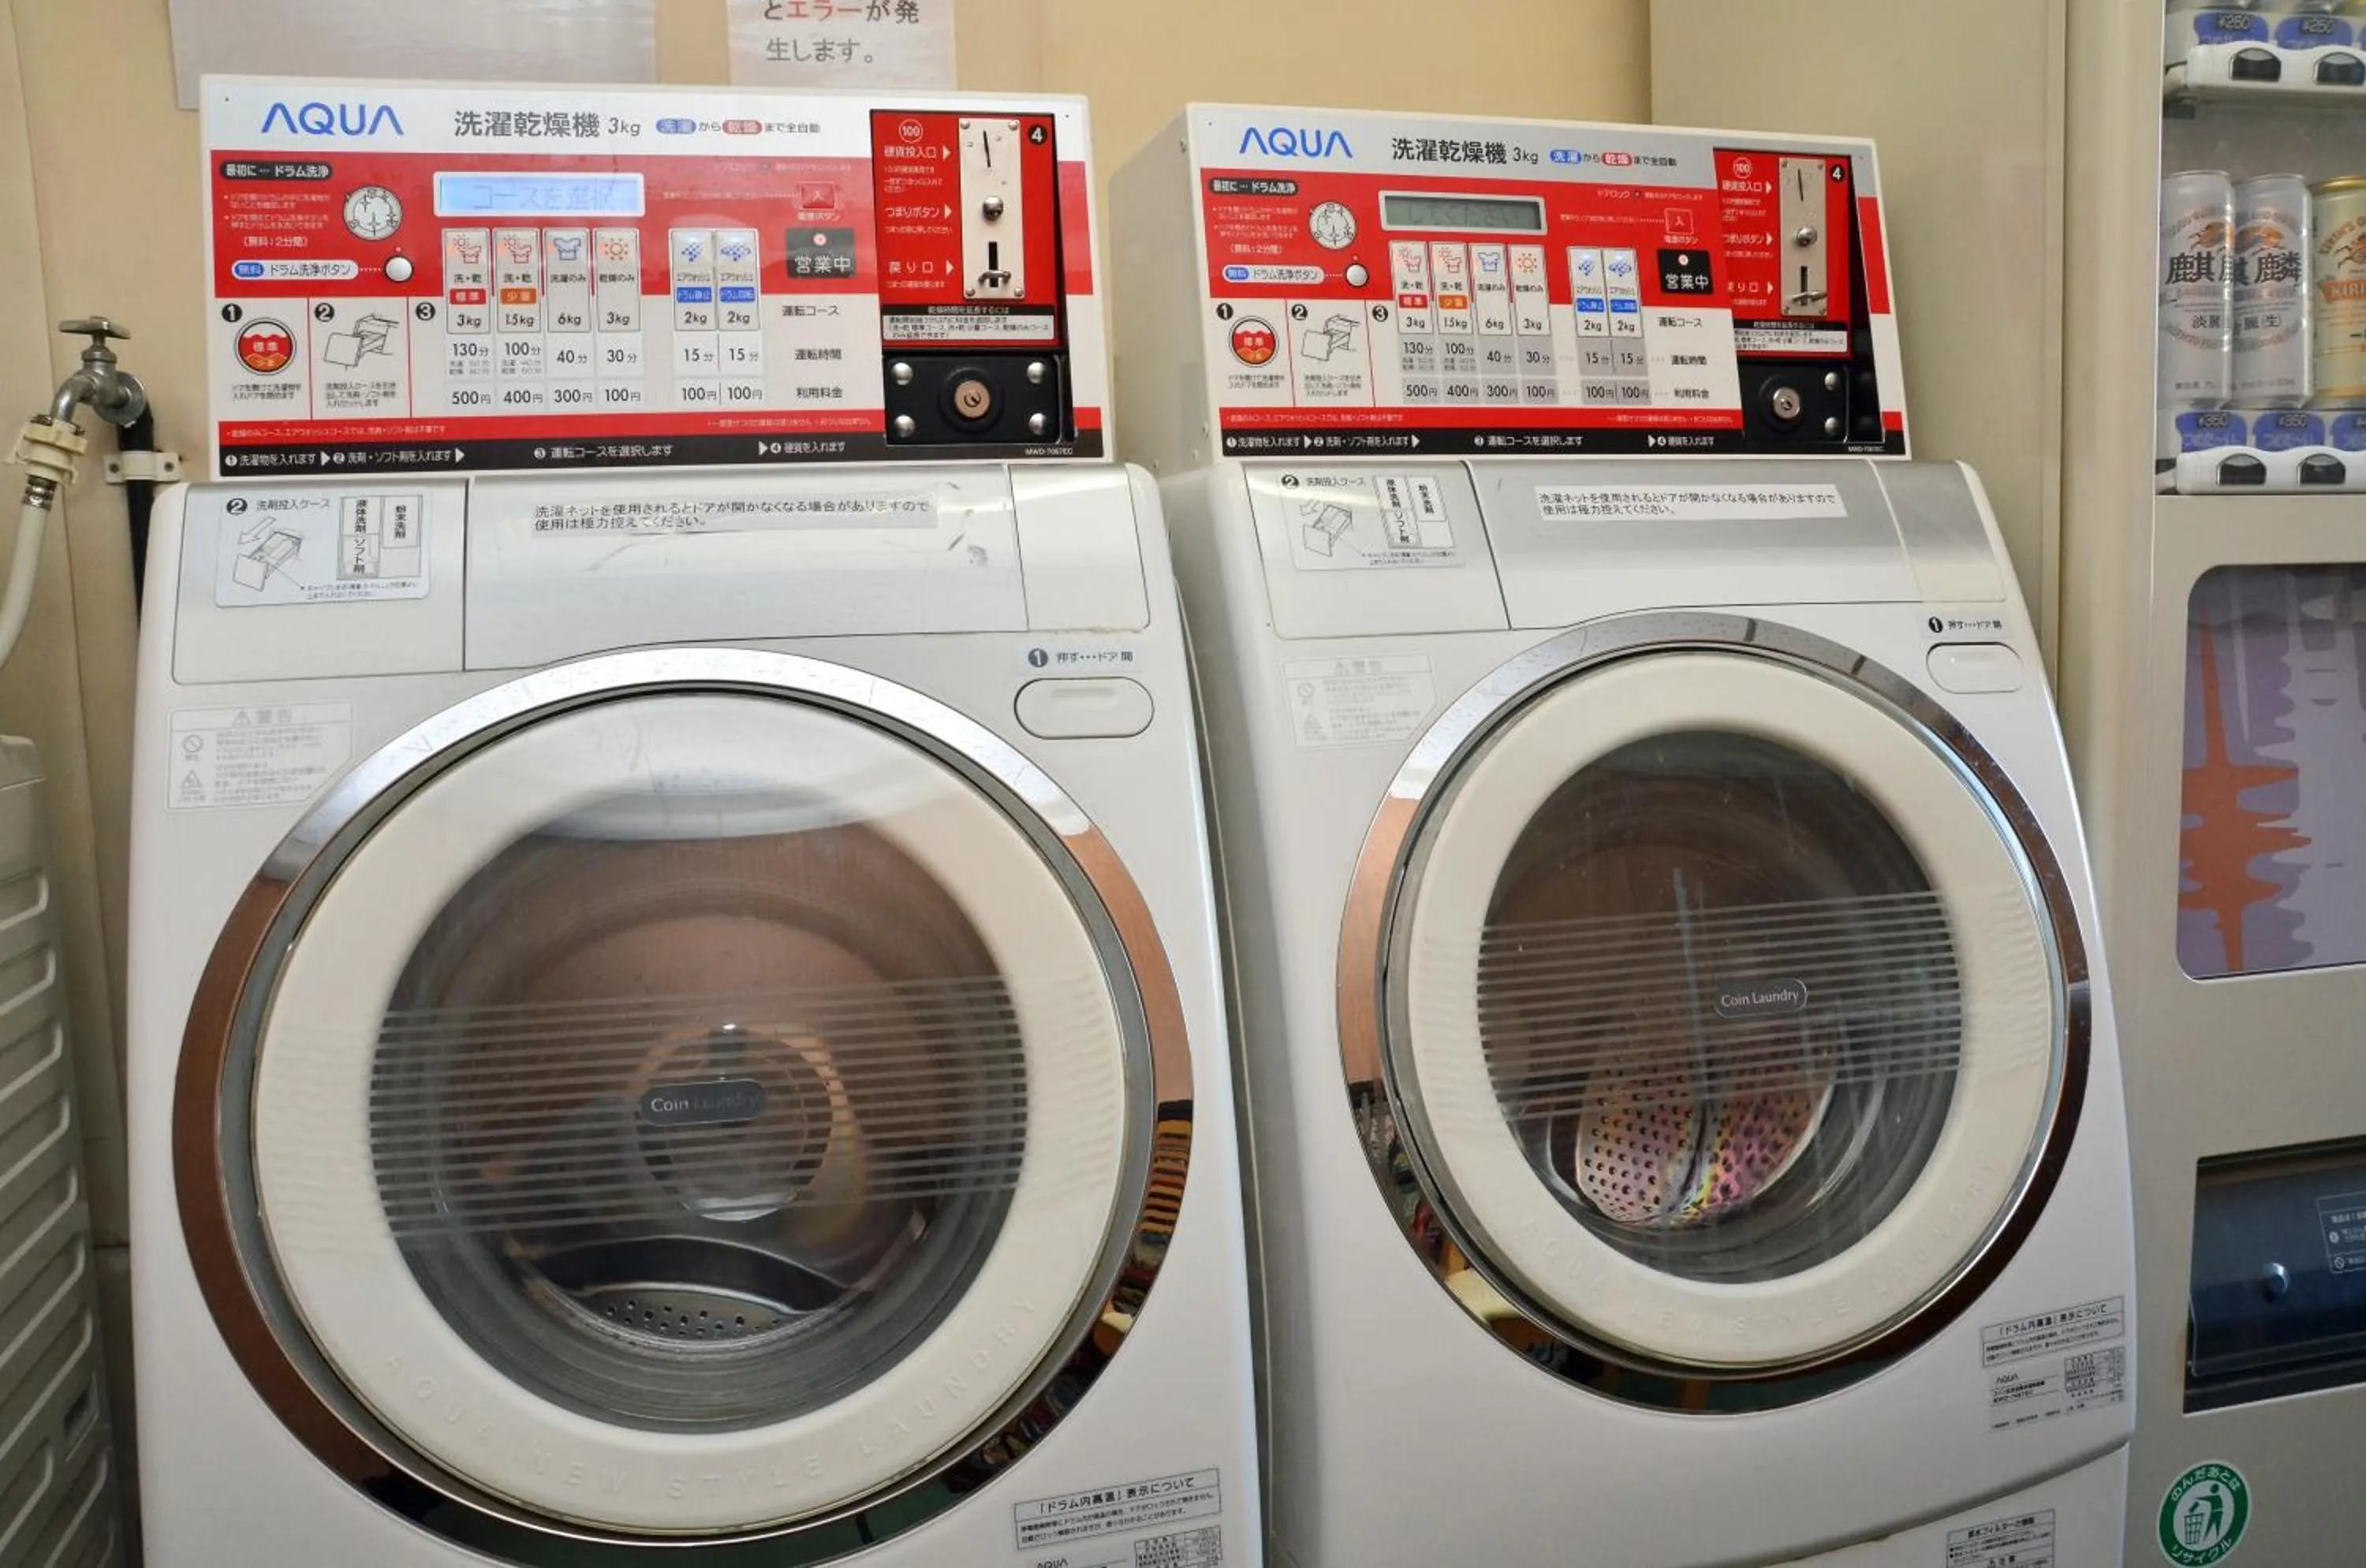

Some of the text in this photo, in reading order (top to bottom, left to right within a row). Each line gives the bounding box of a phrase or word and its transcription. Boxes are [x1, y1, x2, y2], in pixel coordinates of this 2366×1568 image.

[764, 0, 919, 24] とエラーが発
[766, 38, 873, 63] 生します。
[261, 102, 403, 135] AQUA
[454, 111, 640, 137] 洗濯乾燥機 3kg
[901, 126, 920, 137] 100
[1028, 125, 1046, 144] 4
[1240, 127, 1353, 157] AQUA
[1392, 137, 1539, 164] 洗濯乾燥機 3kg
[1831, 166, 1843, 181] 4
[271, 264, 351, 277] ドラム洗浄ボタン
[795, 256, 851, 274] 営業中
[1666, 275, 1708, 289] 営業中
[317, 304, 333, 321] 2
[418, 303, 434, 319] 3
[727, 311, 750, 324] 2kg
[782, 305, 840, 316] 運転コース
[1293, 304, 1307, 319] 2
[457, 315, 482, 327] 3kg
[558, 314, 581, 326] 6kg
[606, 312, 630, 325] 3kg
[684, 312, 707, 325] 2kg
[1406, 317, 1425, 329] 3kg
[1485, 319, 1504, 330] 6kg
[1524, 319, 1542, 330] 3kg
[1584, 320, 1601, 331] 2kg
[1618, 320, 1635, 331] 2kg
[453, 343, 488, 357] 130分
[505, 342, 541, 356] 100分
[556, 349, 587, 363] 40分
[606, 349, 636, 363] 30分
[684, 349, 713, 361] 15分
[729, 349, 759, 361] 15分
[795, 349, 842, 360] 運転時間
[452, 391, 491, 405] 500円
[503, 390, 543, 404] 400円
[554, 389, 592, 403] 300円
[605, 389, 640, 401] 100円
[681, 387, 716, 401] 100円
[728, 386, 763, 400] 100円
[796, 388, 843, 398] 利用料金
[1406, 385, 1437, 397] 500円
[1447, 385, 1478, 397] 400円
[1487, 385, 1517, 398] 300円
[1527, 386, 1555, 398] 100円
[1586, 386, 1614, 398] 100円
[1621, 386, 1648, 398] 100円
[240, 454, 315, 465] 洗濯物を入れます
[551, 445, 673, 457] 運転コースを選択します
[228, 498, 330, 513] 2 洗剤投入ケース
[1721, 989, 1799, 1007] Coin Laundry
[651, 1097, 689, 1112] Coin
[2172, 1540, 2232, 1564] リサイクル
